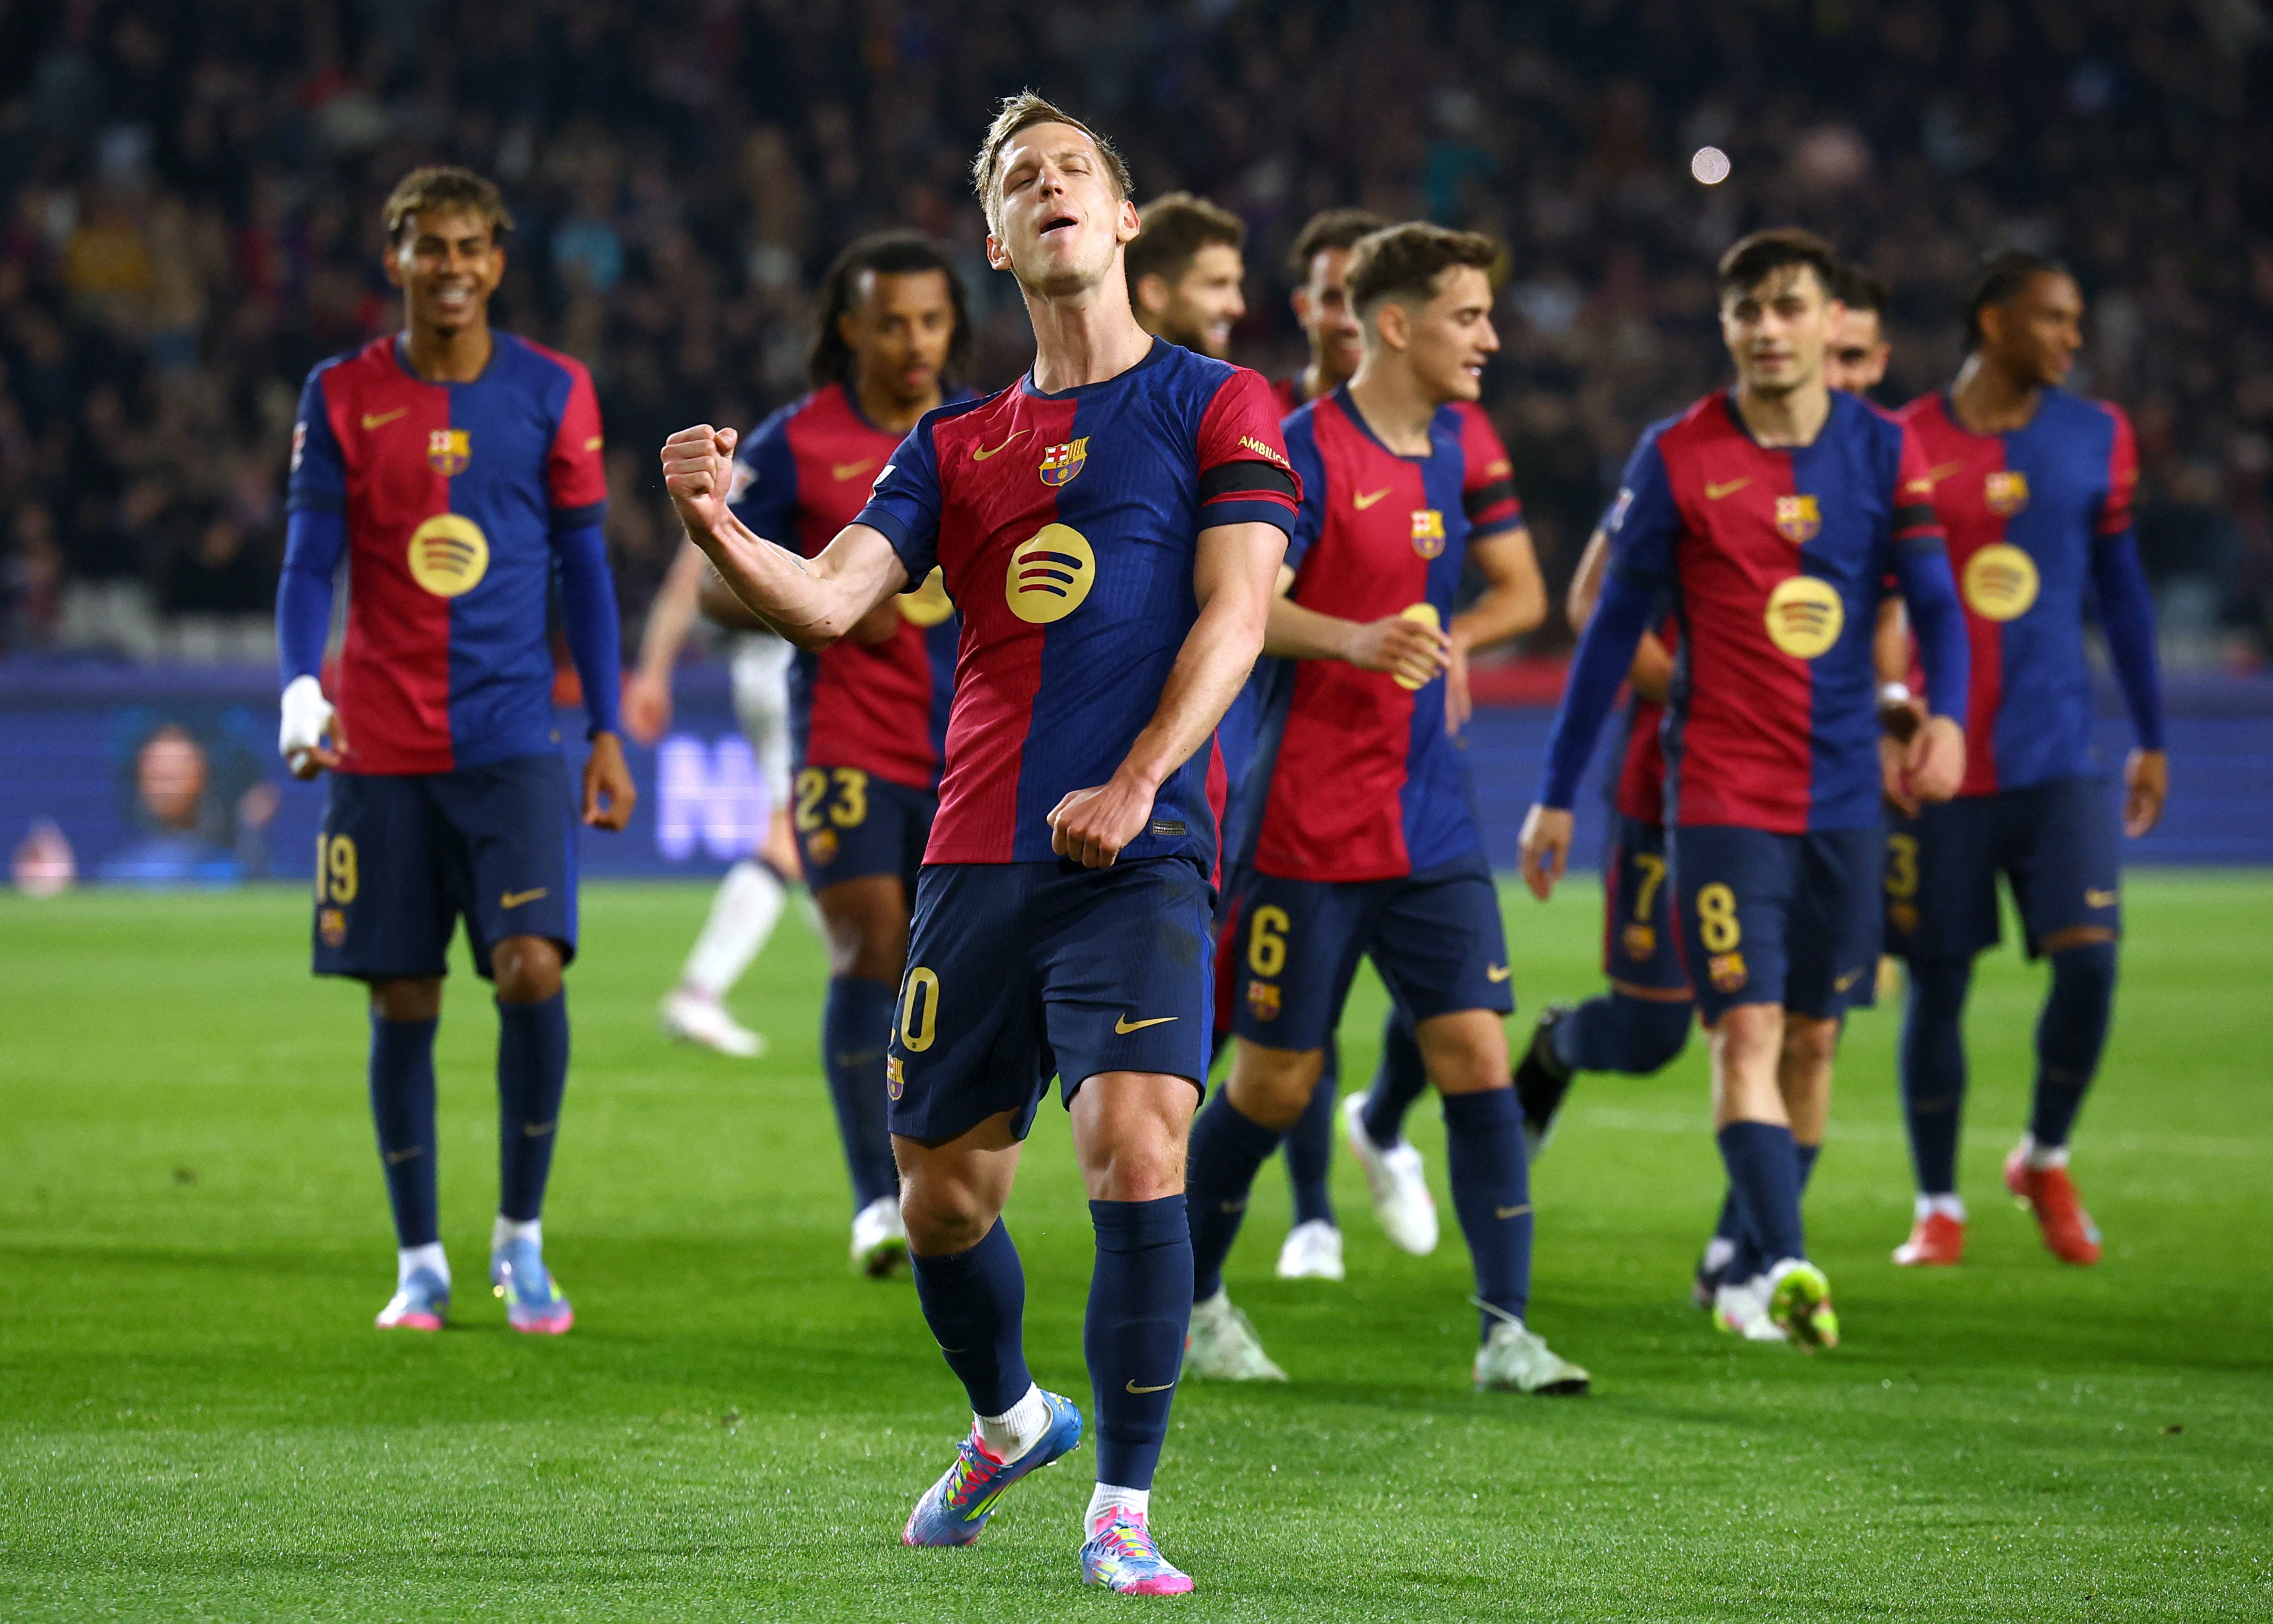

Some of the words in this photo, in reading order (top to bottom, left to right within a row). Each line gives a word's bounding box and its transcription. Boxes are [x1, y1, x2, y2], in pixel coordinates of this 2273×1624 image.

[1055, 458, 1073, 468] FCB
[796, 766, 869, 832] 23
[317, 833, 358, 905] 19
[1634, 853, 1667, 922] 7
[1886, 836, 1919, 896] 3
[1248, 905, 1291, 977] 6
[1696, 881, 1741, 953] 8
[890, 967, 939, 1052] 0
